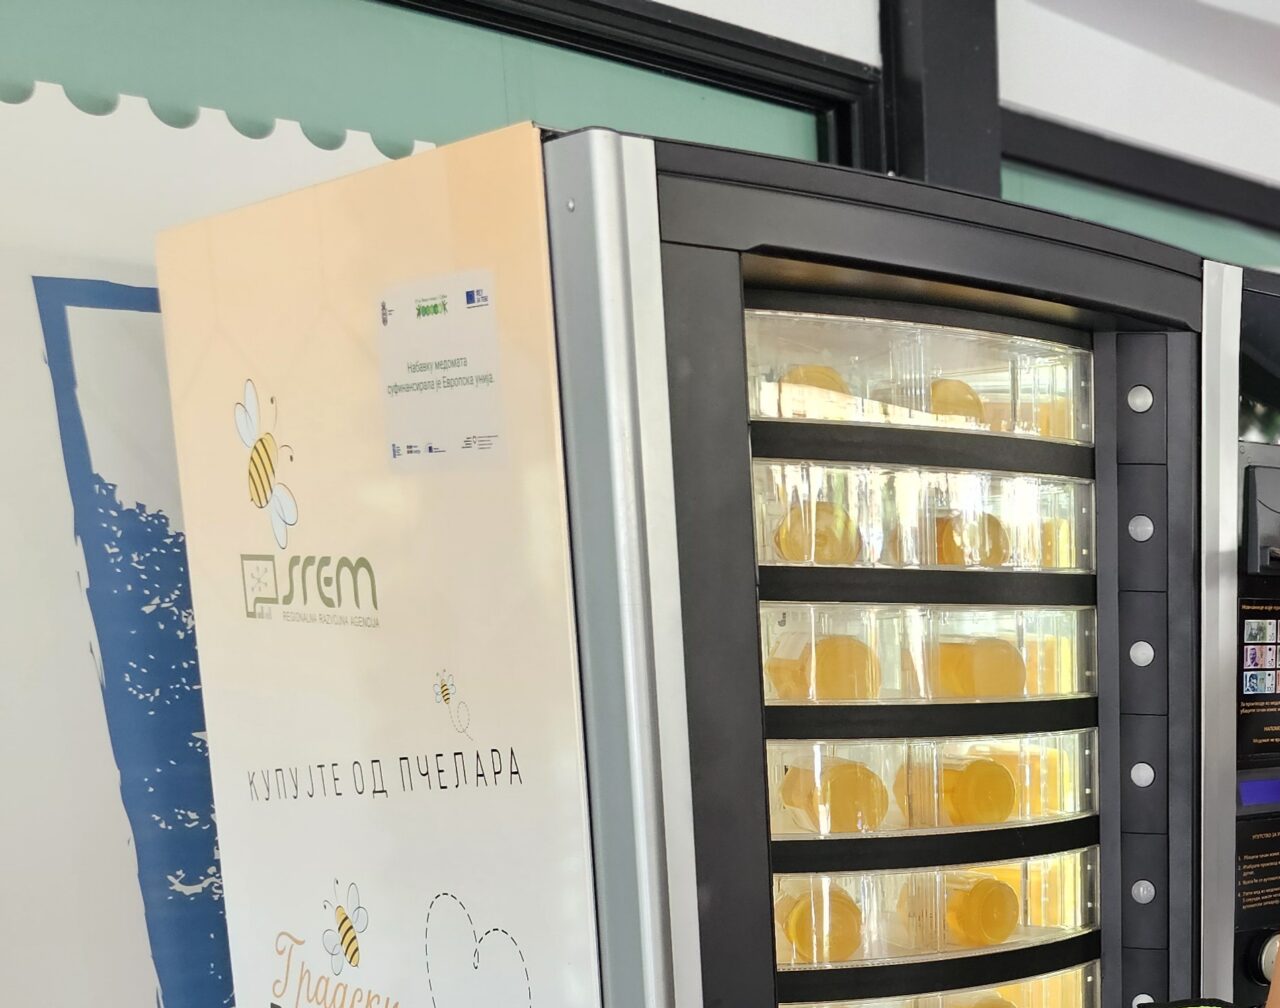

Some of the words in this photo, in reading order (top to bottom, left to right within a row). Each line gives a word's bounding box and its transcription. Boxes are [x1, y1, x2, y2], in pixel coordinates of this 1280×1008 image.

[407, 361, 433, 374] Набавку
[435, 357, 468, 371] медомата
[443, 375, 474, 390] Европска
[247, 763, 342, 801] КУПУЈТЕ
[352, 759, 388, 799] ОД
[399, 747, 523, 792] ПЧЕЛАРА
